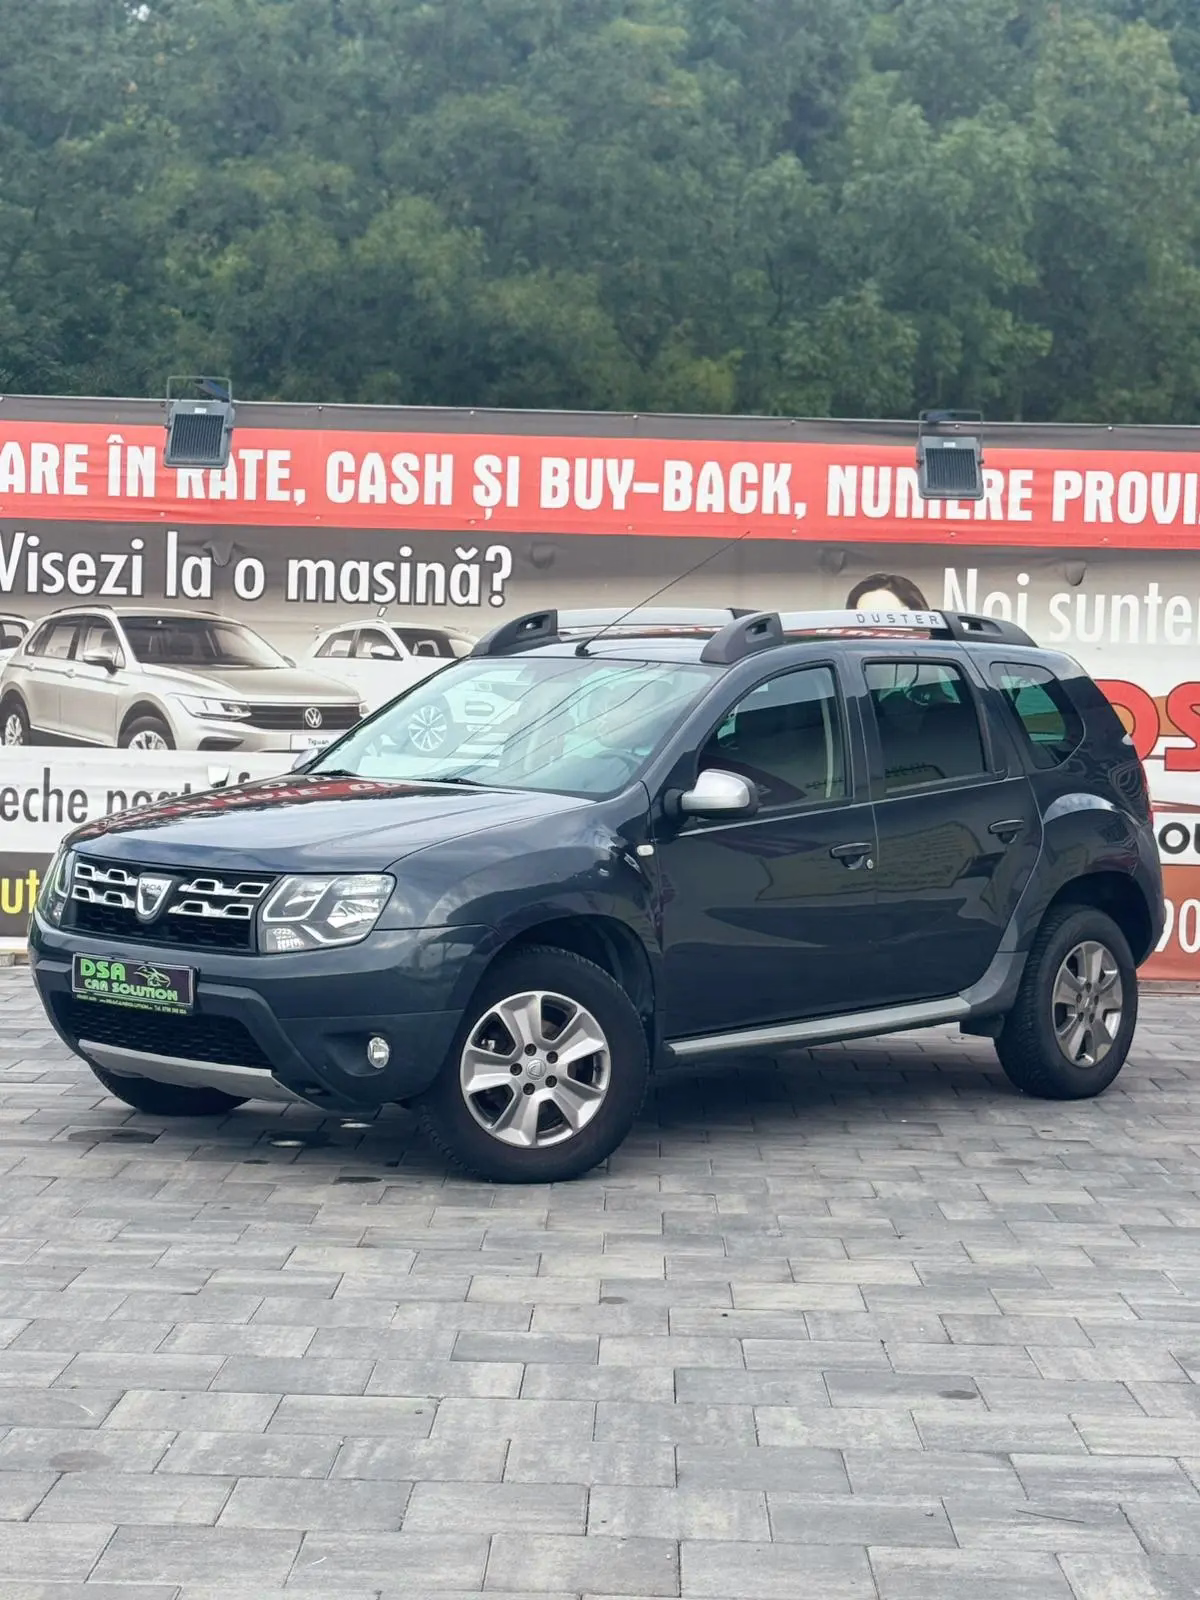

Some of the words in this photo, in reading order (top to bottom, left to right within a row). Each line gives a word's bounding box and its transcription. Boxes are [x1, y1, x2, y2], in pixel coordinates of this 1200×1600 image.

[0, 441, 89, 496] ARE
[106, 434, 156, 498] ÎN
[326, 450, 454, 505] CASH
[472, 454, 520, 521] ȘI
[539, 456, 807, 520] BUY-BACK,
[1052, 469, 1200, 525] PROVI
[0, 532, 145, 596] Visezi
[166, 531, 212, 598] la
[234, 557, 265, 600] o
[287, 545, 513, 618] mașină?
[856, 613, 939, 625] DUSTER
[1049, 582, 1200, 645] sunte
[80, 958, 126, 981] DSA
[111, 981, 178, 1001] SOLUTION
